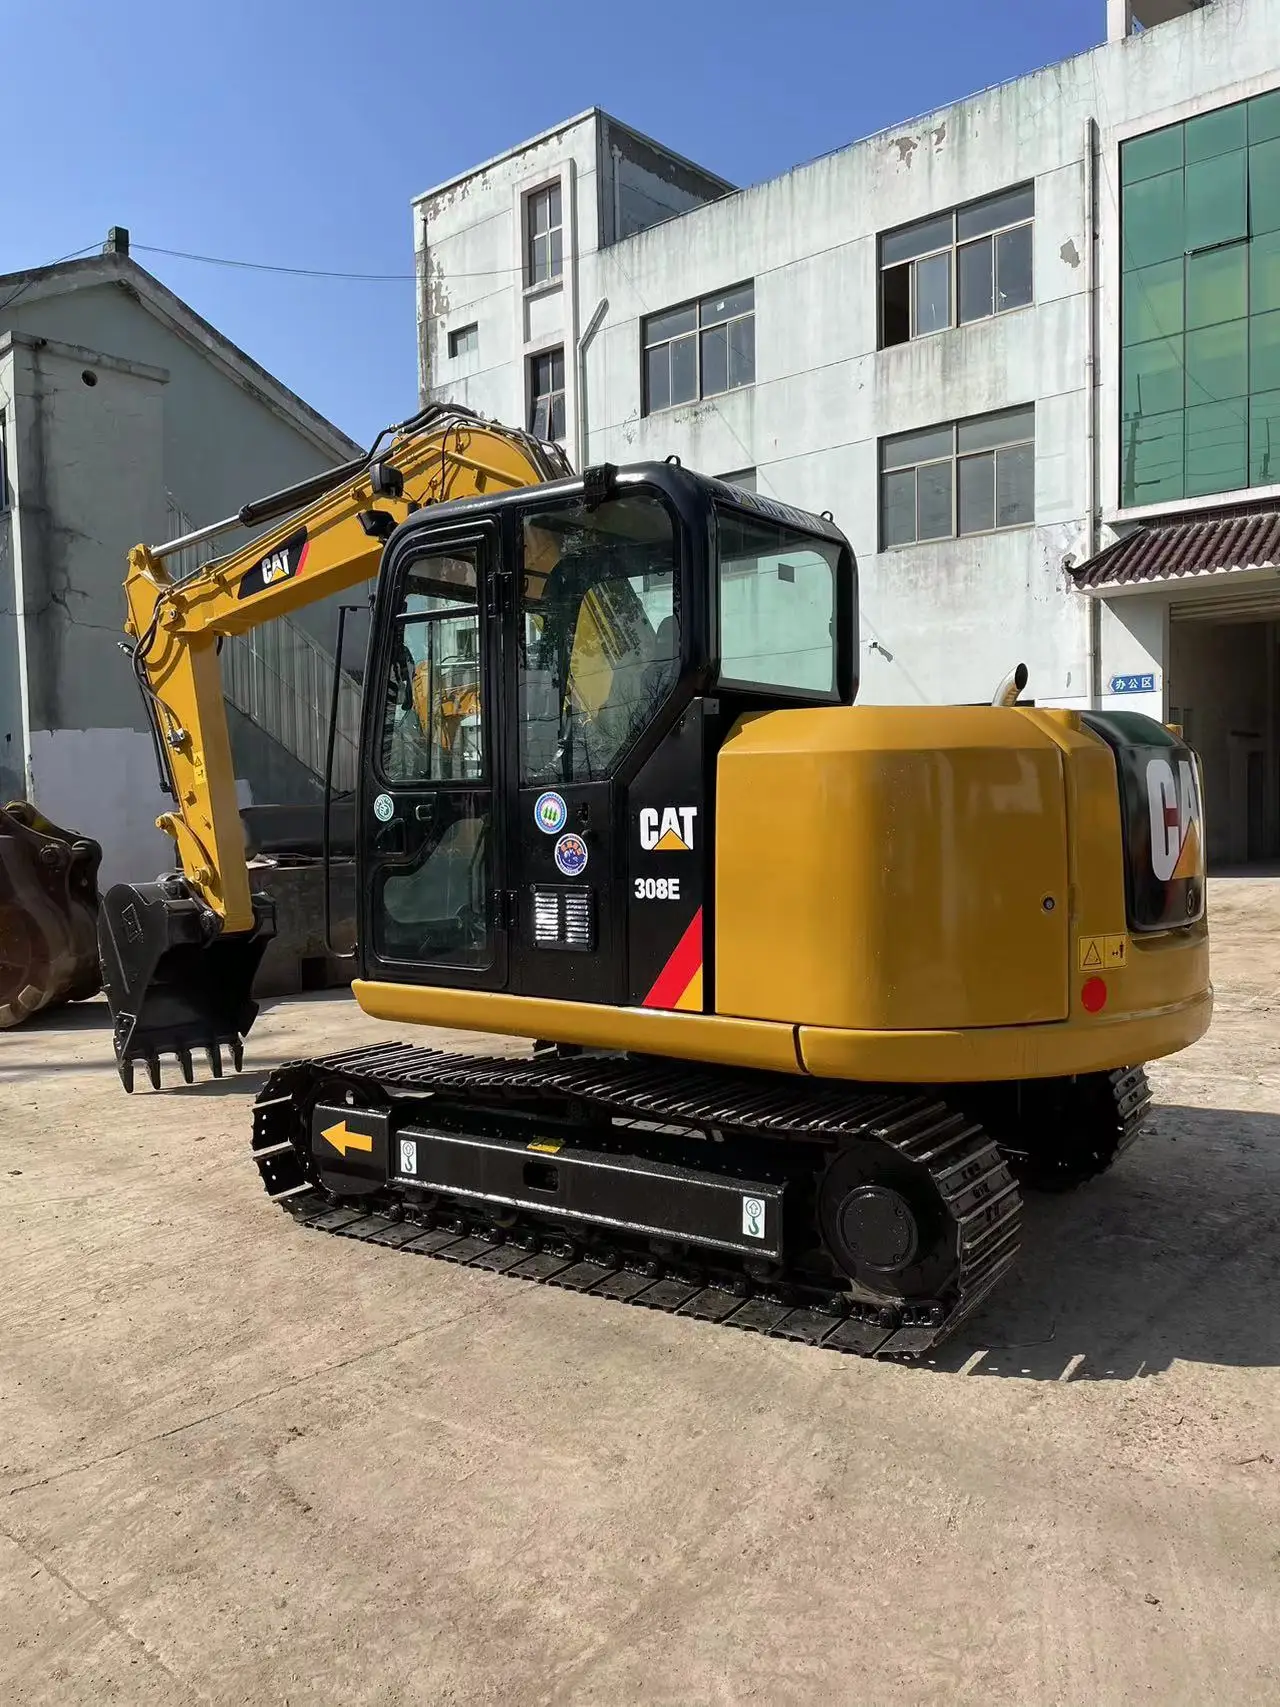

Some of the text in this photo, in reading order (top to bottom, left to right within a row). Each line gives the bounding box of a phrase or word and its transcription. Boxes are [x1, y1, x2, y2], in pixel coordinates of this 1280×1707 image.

[261, 548, 290, 584] CAT
[1115, 676, 1152, 690] 办公区
[639, 806, 698, 850] CAT
[634, 878, 681, 900] 308E
